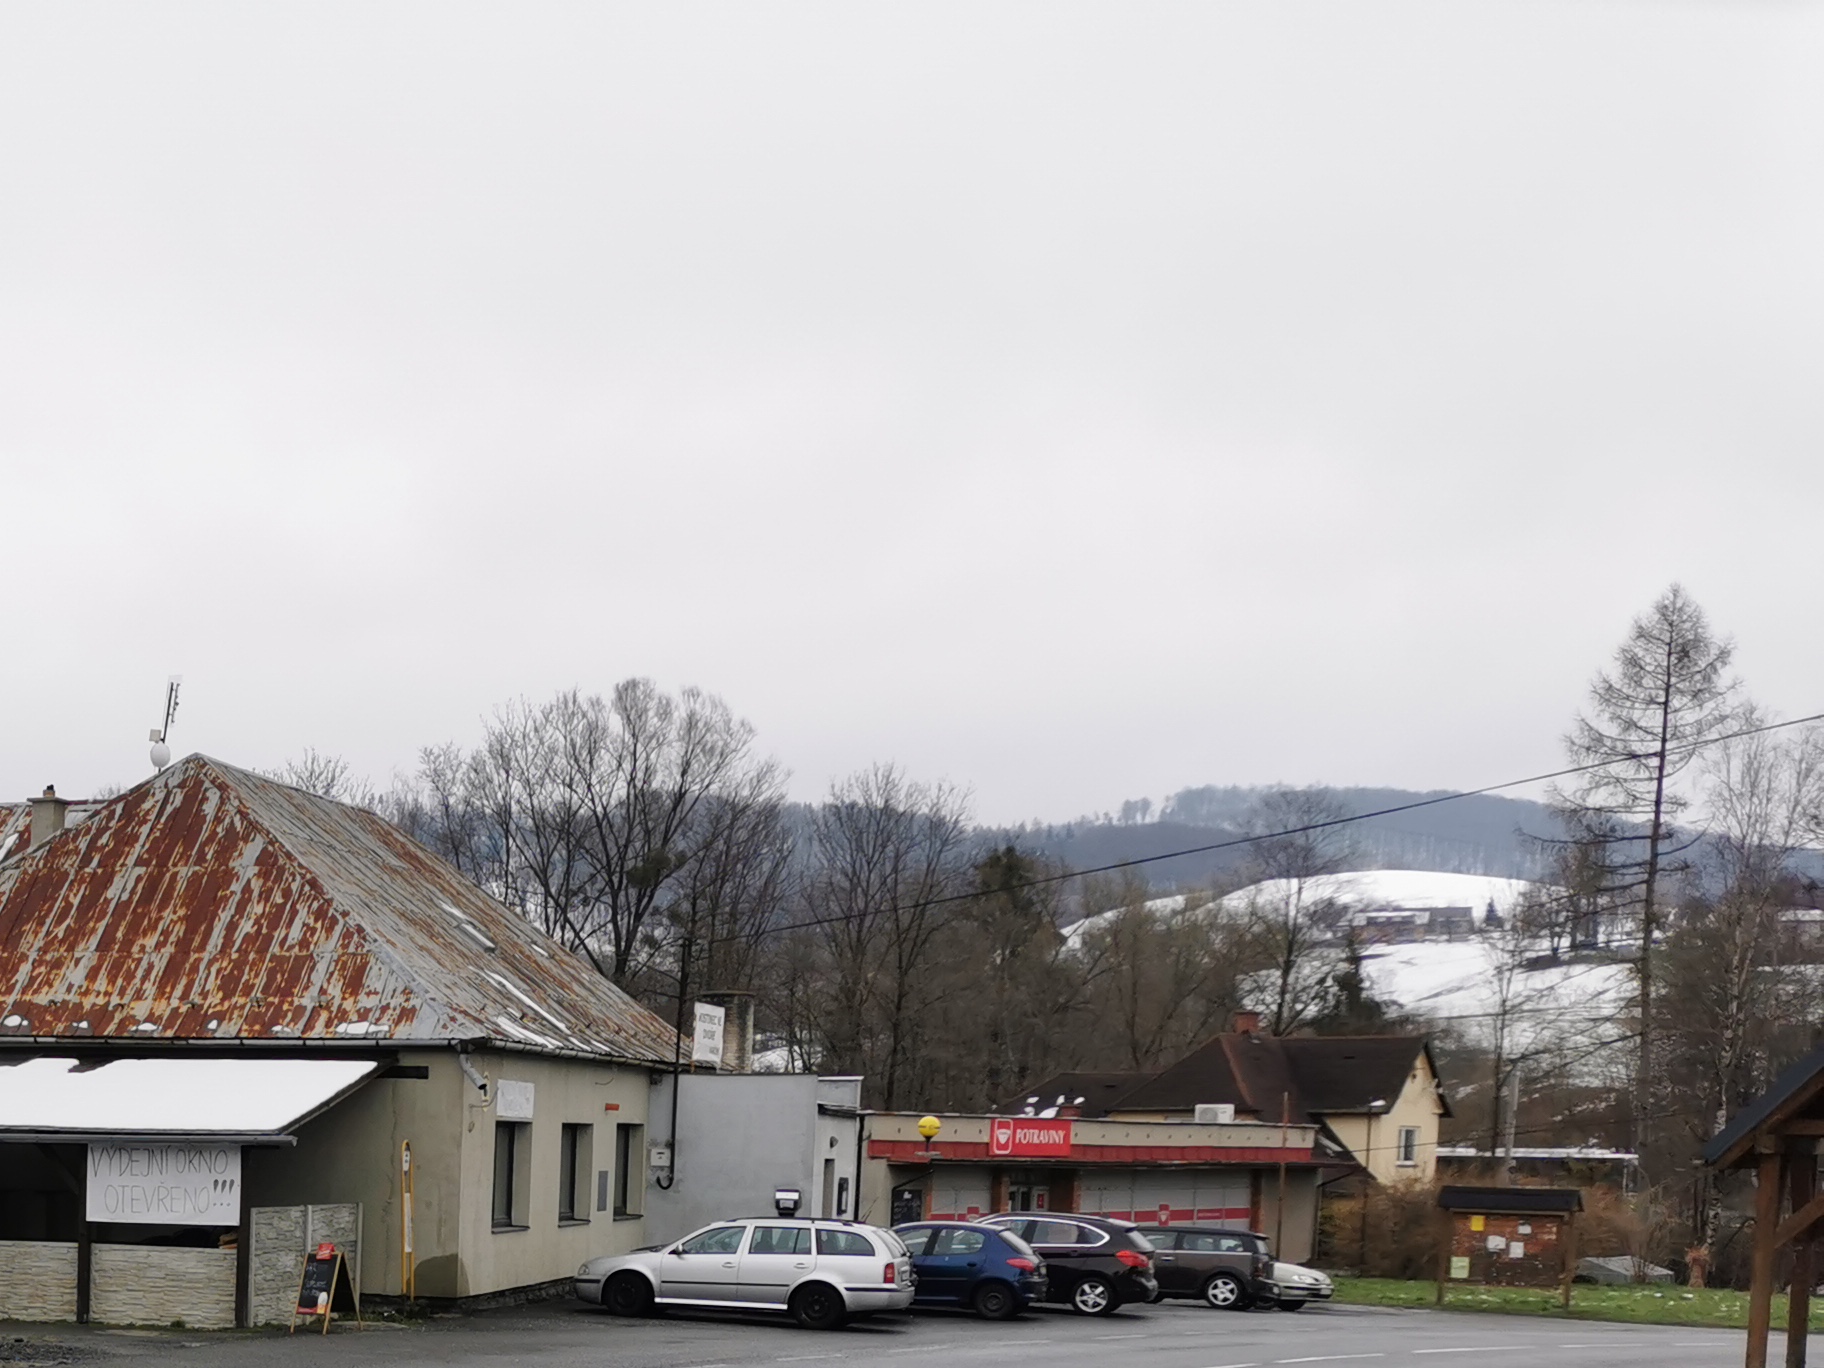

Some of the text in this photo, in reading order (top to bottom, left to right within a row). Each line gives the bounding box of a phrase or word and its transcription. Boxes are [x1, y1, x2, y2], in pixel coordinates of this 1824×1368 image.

[1016, 1129, 1066, 1144] POTRAVINY
[90, 1144, 229, 1177] VÝDEJNÍ OKNO
